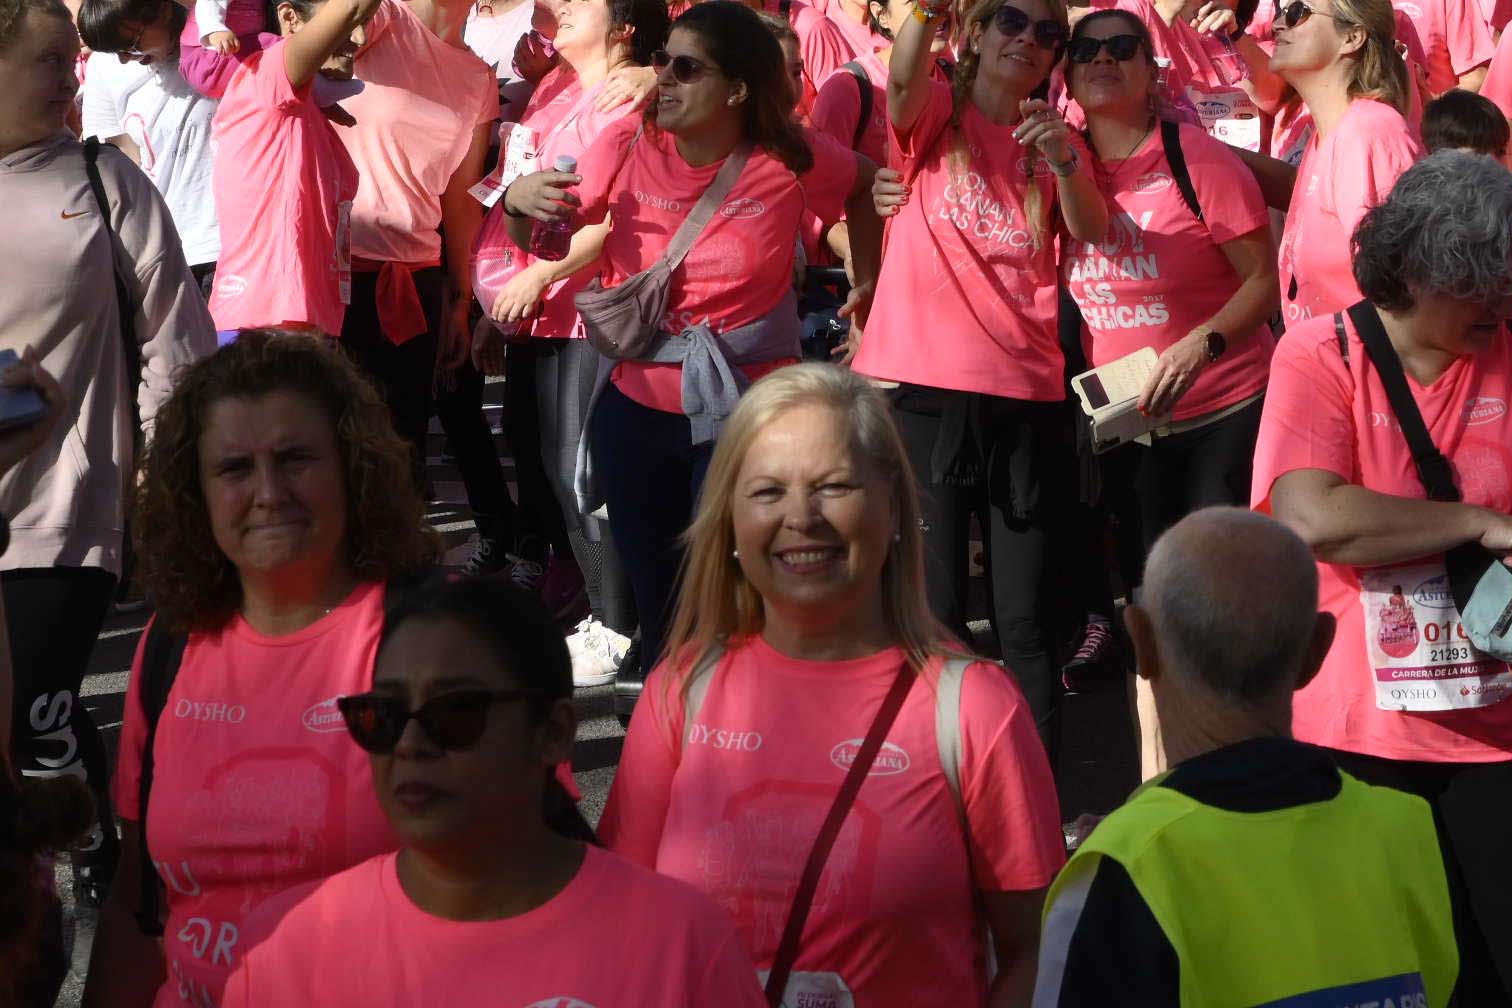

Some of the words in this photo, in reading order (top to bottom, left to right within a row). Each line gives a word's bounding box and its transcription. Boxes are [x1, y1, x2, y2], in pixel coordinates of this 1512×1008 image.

[634, 190, 681, 212] OYSHO
[974, 217, 1040, 250] CHICA
[1080, 303, 1170, 330] CHICAS
[1431, 647, 1468, 663] 21293
[1392, 668, 1432, 679] CARRERA
[1434, 667, 1447, 677] DE
[1447, 667, 1459, 676] LA
[1391, 687, 1437, 700] OYSHO
[175, 697, 246, 725] OYSHO
[688, 723, 763, 753] OYSHO
